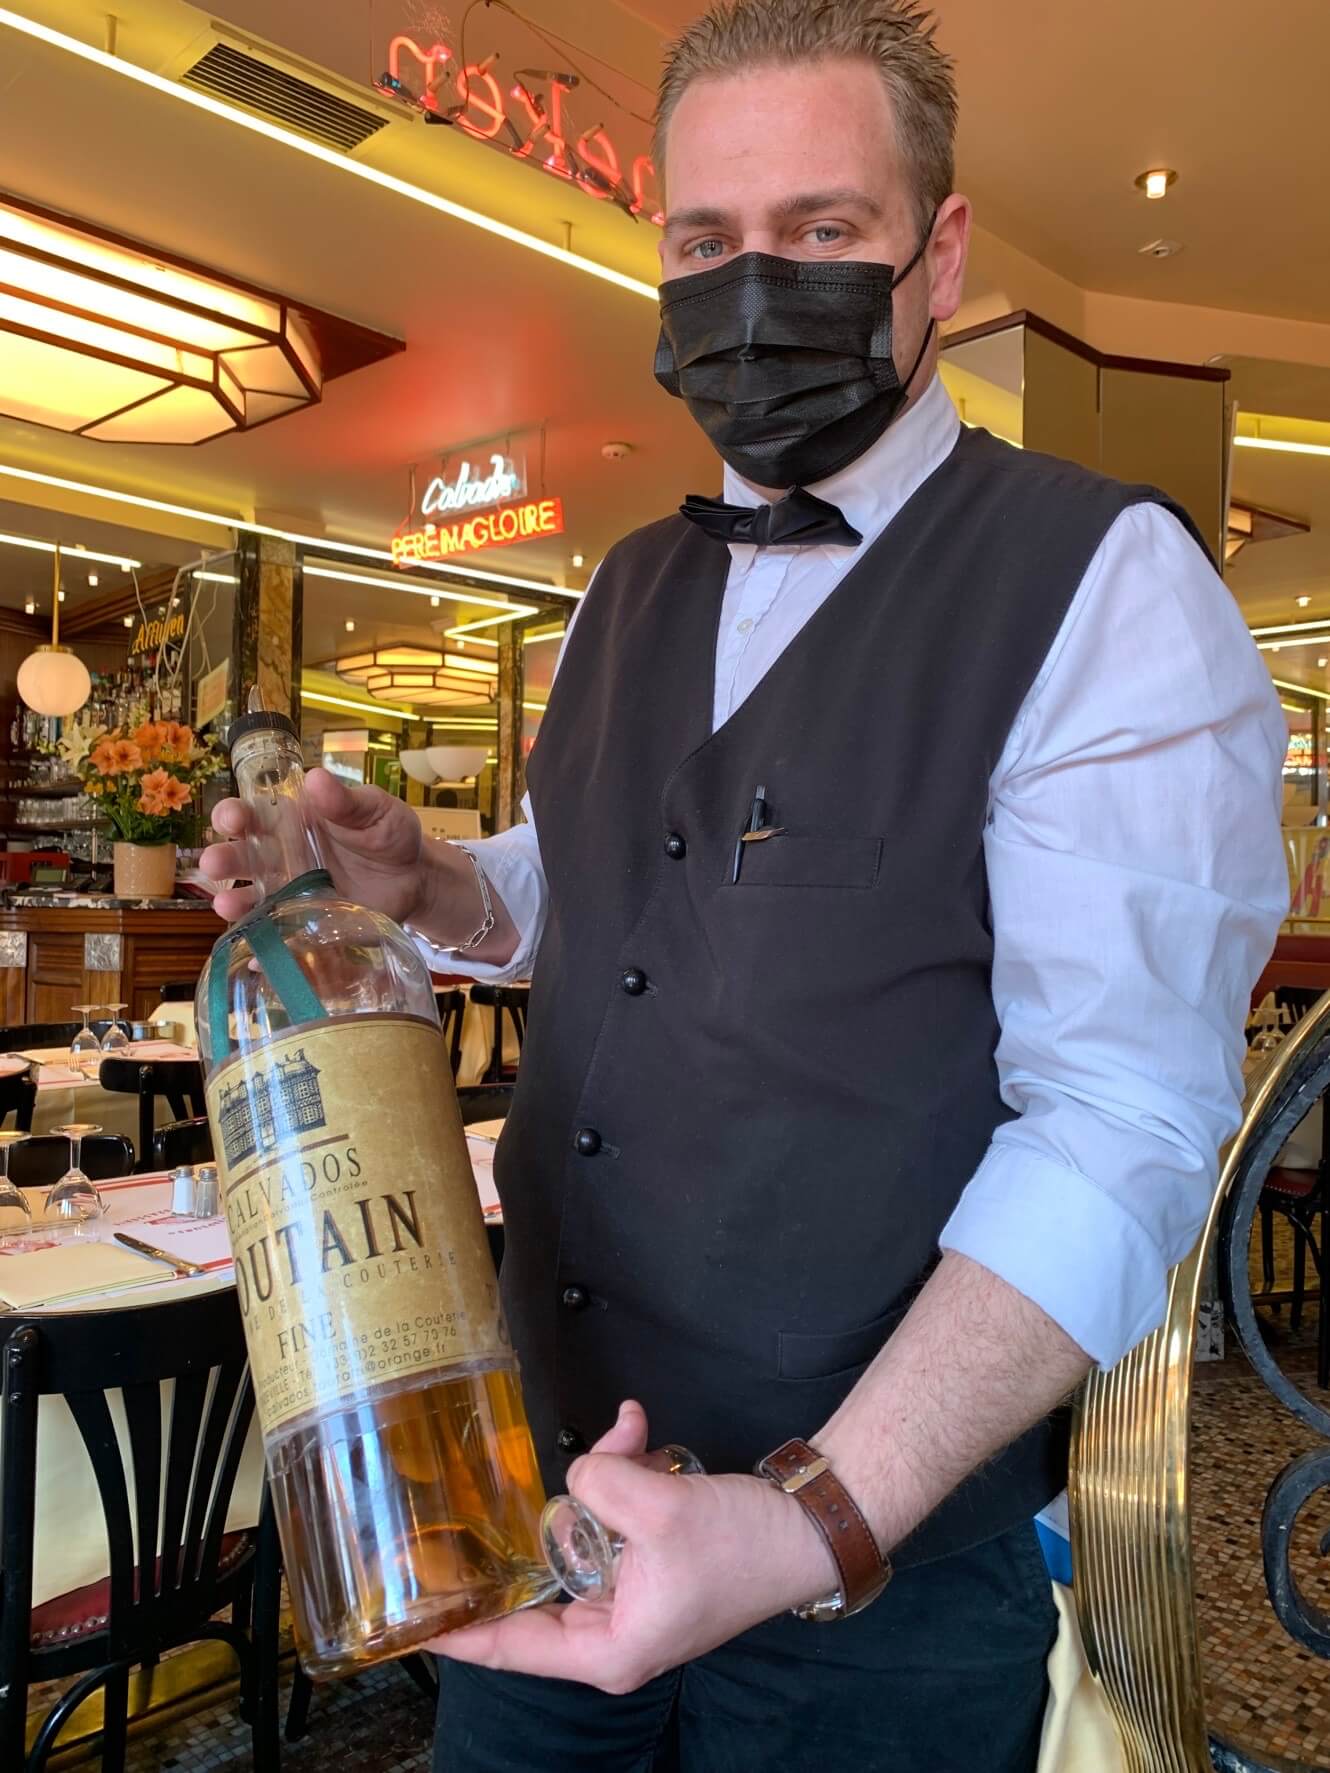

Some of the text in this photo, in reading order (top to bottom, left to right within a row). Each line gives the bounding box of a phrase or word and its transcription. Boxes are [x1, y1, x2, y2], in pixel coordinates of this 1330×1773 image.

[440, 501, 555, 554] MAGLOIRE
[227, 1147, 361, 1235] CALVADOS
[236, 1190, 425, 1318] OUTAIN
[268, 1298, 288, 1322] DE
[343, 1250, 458, 1289] COUTERIE
[277, 1312, 337, 1360] FINE
[374, 1327, 391, 1341] de
[396, 1321, 410, 1334] la
[381, 1338, 398, 1353] 32
[403, 1333, 418, 1347] 57
[443, 1326, 457, 1338] 76
